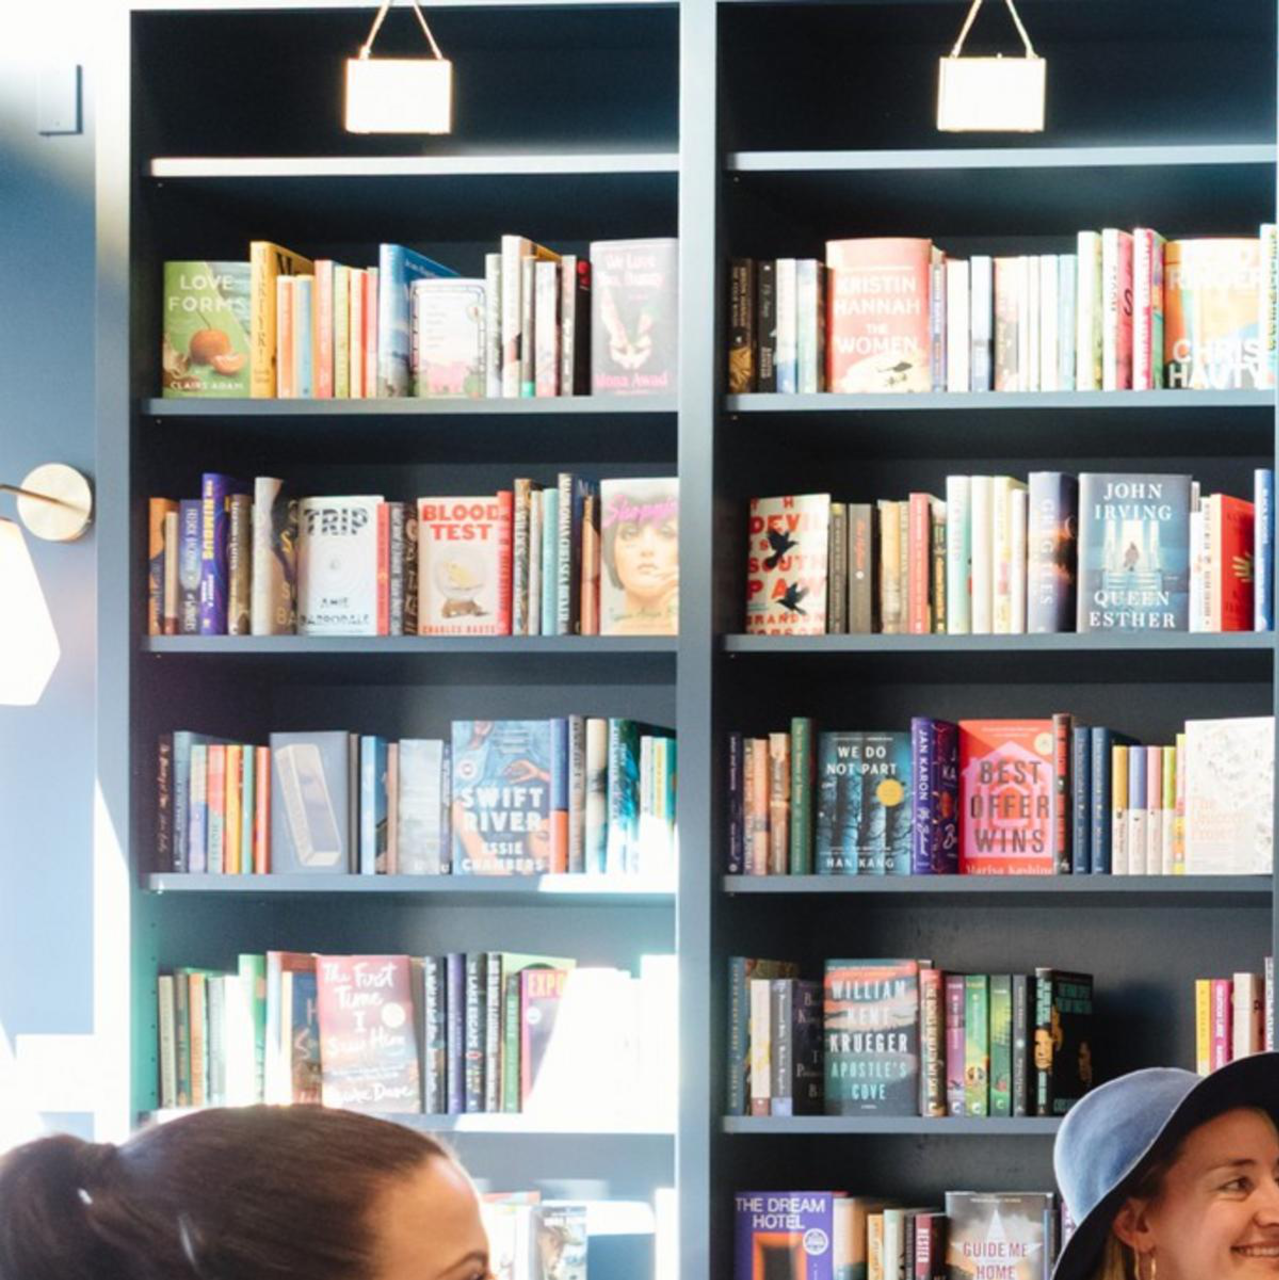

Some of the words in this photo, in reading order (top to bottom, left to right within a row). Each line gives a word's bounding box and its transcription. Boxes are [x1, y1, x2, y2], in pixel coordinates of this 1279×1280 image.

[180, 275, 235, 290] LOVE
[836, 276, 917, 294] KRISTIN
[834, 299, 922, 315] HANNAH
[835, 337, 919, 355] WOMEN
[1104, 483, 1162, 499] JOHN
[422, 505, 499, 521] BLOOD
[1095, 504, 1173, 521] IRVING
[304, 508, 369, 536] TRIP
[430, 524, 493, 540] TEST
[1094, 591, 1170, 608] QUEEN
[1089, 612, 1175, 628] ESTHER
[919, 729, 929, 753] JAN
[838, 746, 859, 759] WE
[864, 746, 886, 759] DO
[826, 762, 856, 776] NOT
[861, 762, 897, 776] PART
[979, 761, 1040, 785] BEST
[919, 757, 929, 800] KARON
[461, 787, 543, 808] SWIFT
[970, 795, 1049, 820] OFFER
[463, 810, 543, 831] RIVER
[481, 840, 523, 855] ESSIE
[975, 829, 1045, 854] WINS
[826, 856, 852, 869] HAN
[858, 856, 895, 869] KANG
[323, 963, 351, 984] The
[338, 987, 384, 1009] Time
[468, 976, 478, 1004] LAKE
[832, 979, 907, 1001] WILLIAM
[353, 1010, 365, 1032] I
[468, 1007, 478, 1047] ESCAPE
[830, 1034, 908, 1053] KRUEGER
[831, 1062, 907, 1080] APOSTLE'S
[852, 1083, 887, 1100] COVE
[735, 1198, 762, 1213] THE
[767, 1198, 825, 1213] DREAM
[752, 1214, 805, 1229] HOTEL
[963, 1242, 1005, 1257] GUIDE
[1009, 1242, 1028, 1257] ME
[976, 1265, 1015, 1280] HOME
